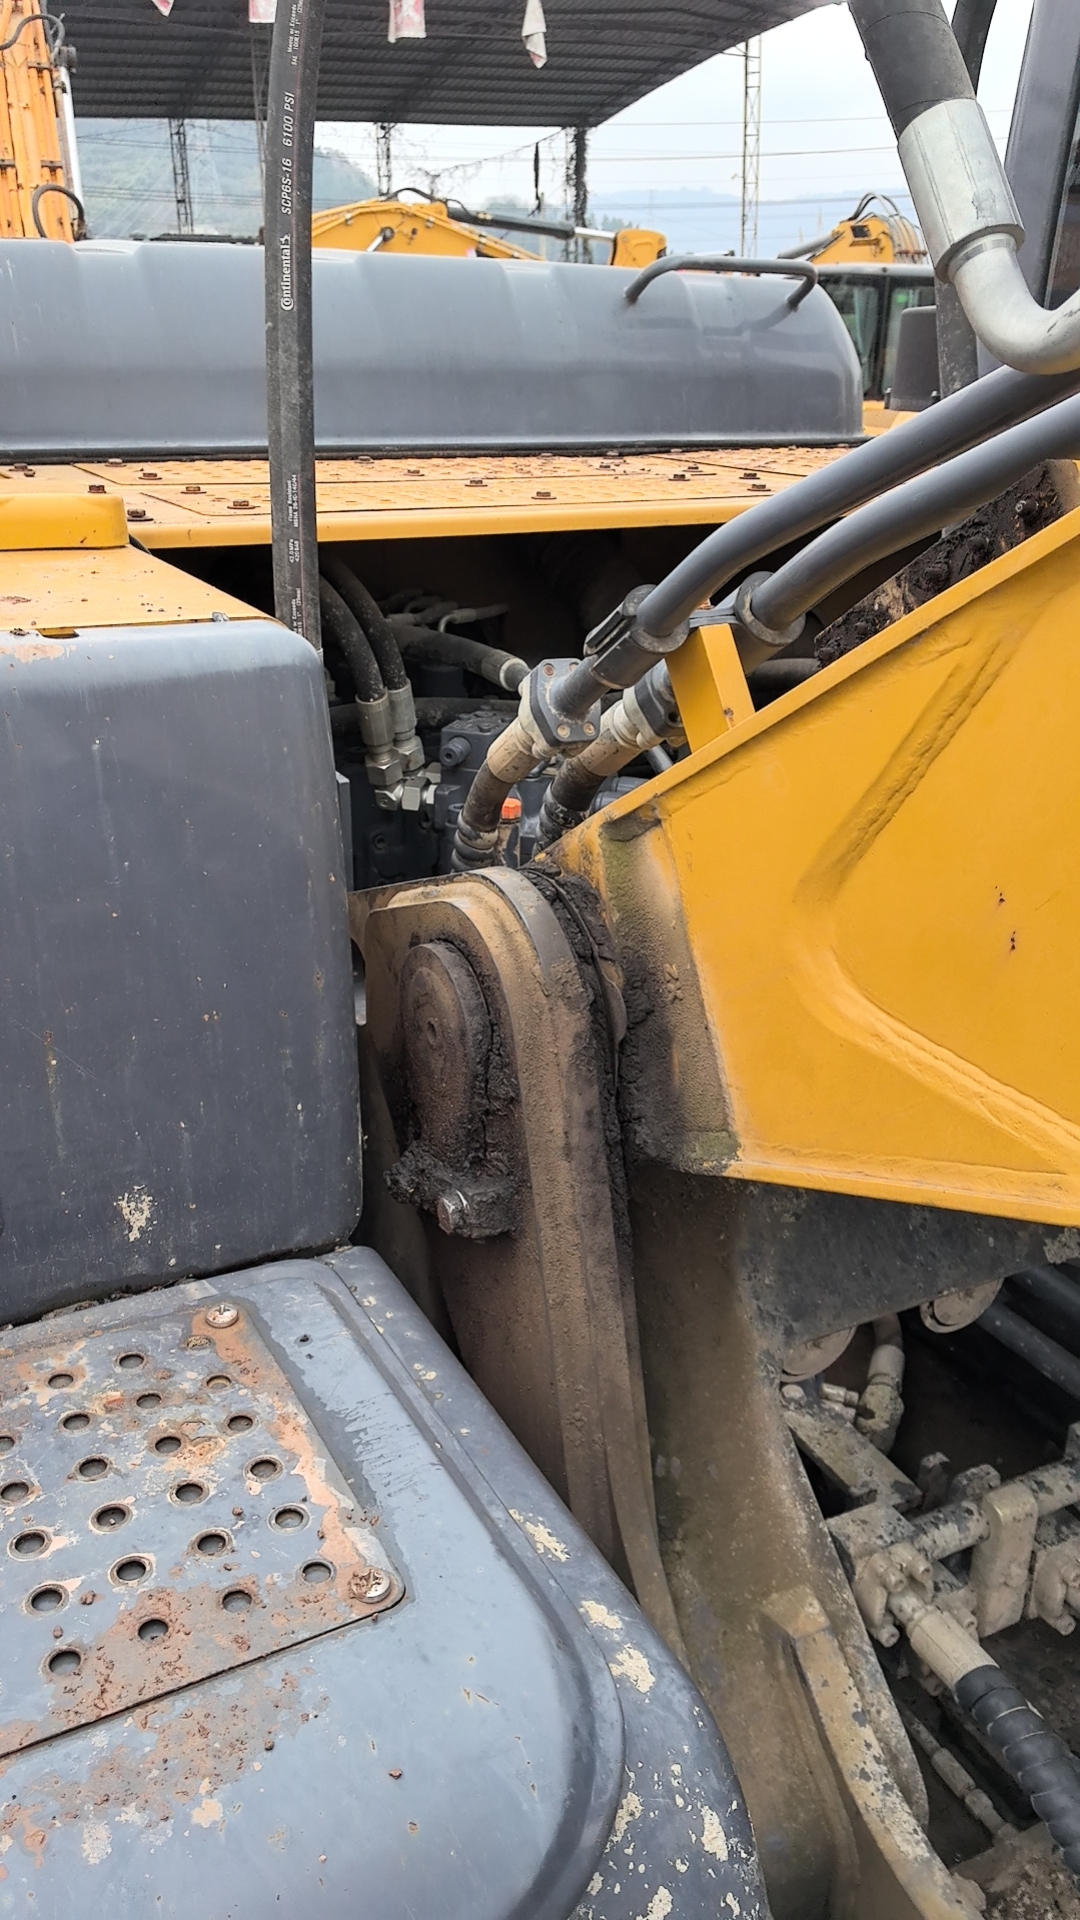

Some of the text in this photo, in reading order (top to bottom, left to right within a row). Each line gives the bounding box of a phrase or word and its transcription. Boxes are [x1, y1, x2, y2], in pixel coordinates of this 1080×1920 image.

[280, 91, 295, 311] Continental SCP6S-16 6100 PSI
